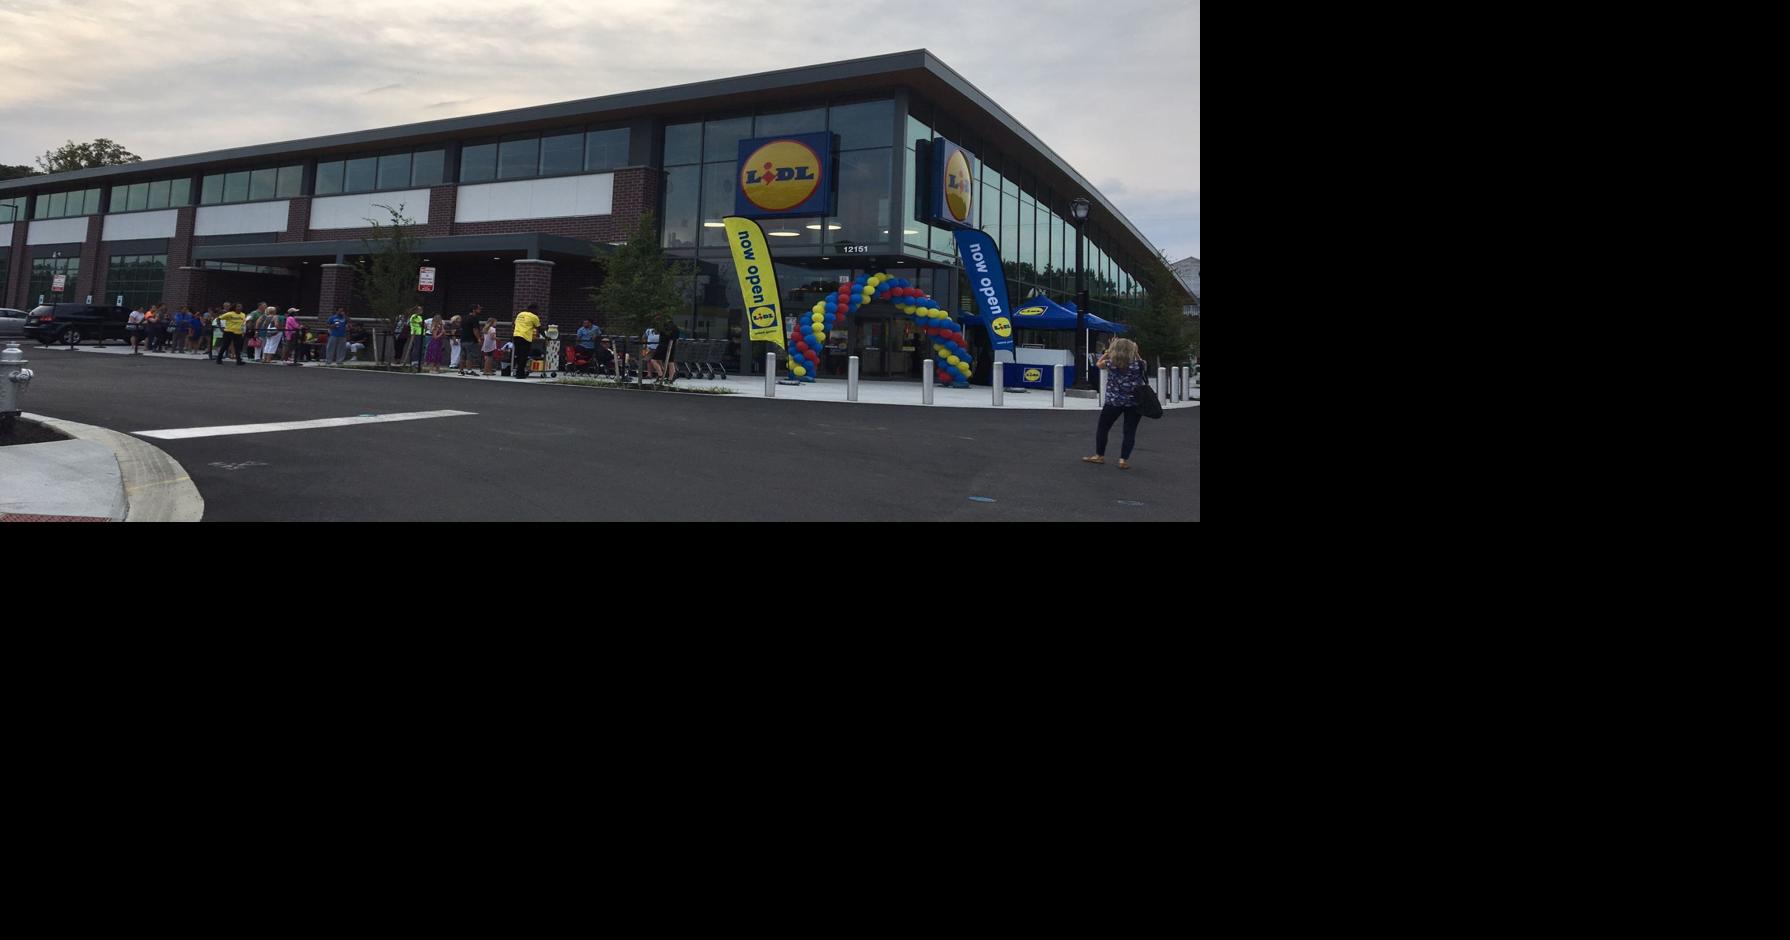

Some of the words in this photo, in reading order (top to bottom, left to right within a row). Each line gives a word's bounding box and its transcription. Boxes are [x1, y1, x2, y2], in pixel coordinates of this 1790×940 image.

[738, 231, 755, 261] now
[843, 245, 868, 253] 12151
[745, 266, 764, 304] open
[970, 243, 988, 273] now
[979, 278, 1001, 315] open
